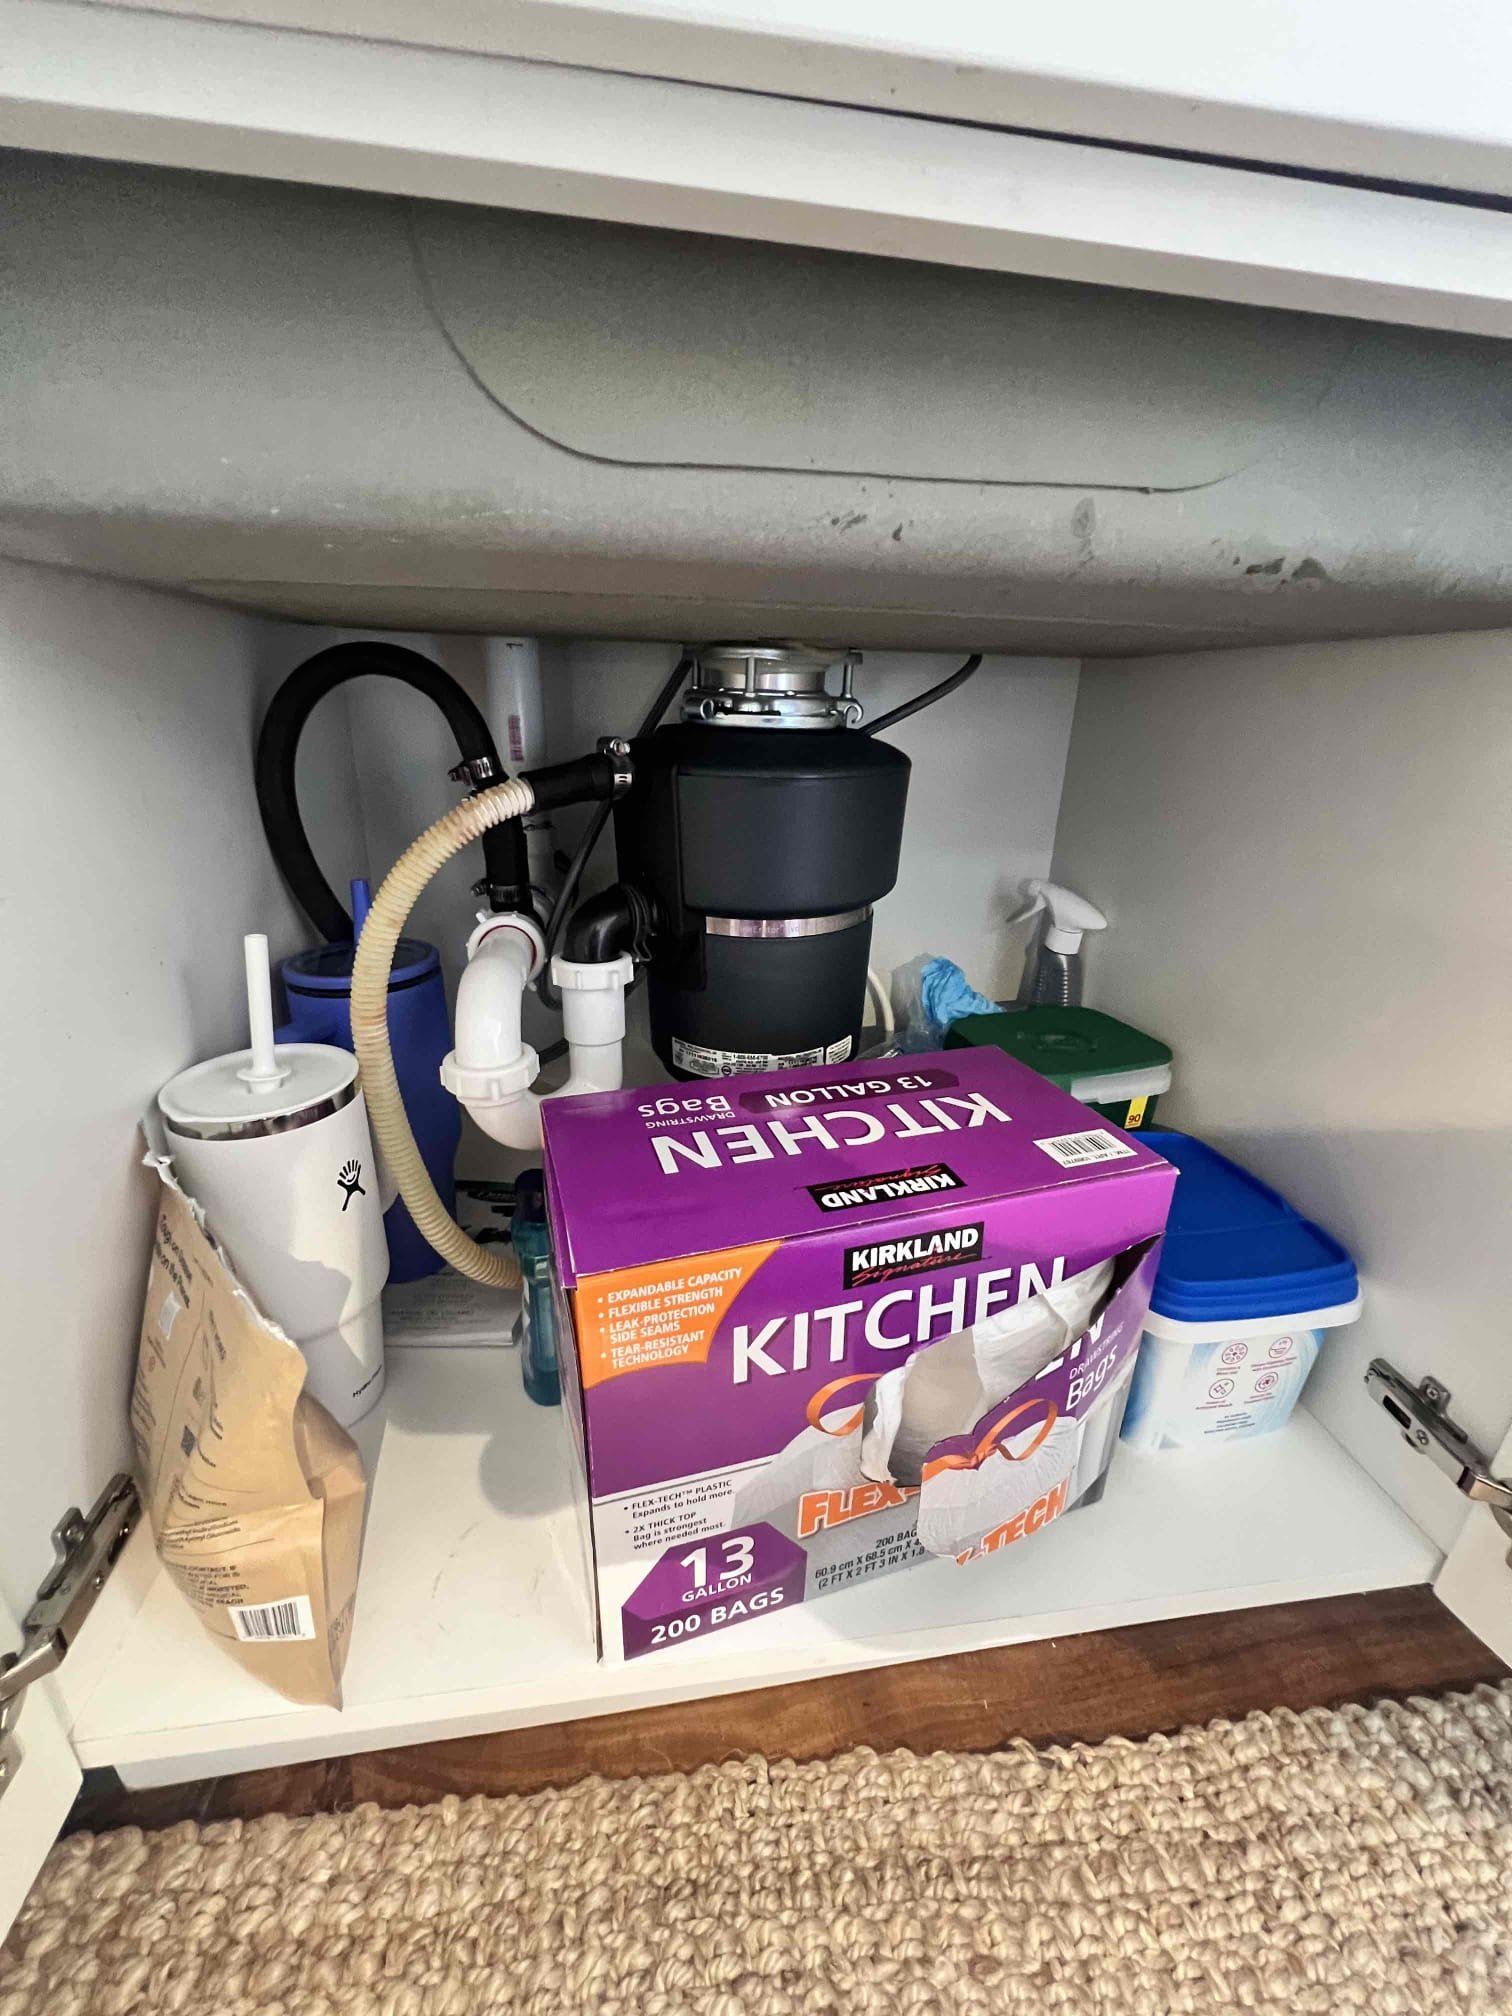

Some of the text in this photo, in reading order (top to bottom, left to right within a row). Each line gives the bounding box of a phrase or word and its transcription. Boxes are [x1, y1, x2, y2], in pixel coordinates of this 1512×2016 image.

[637, 1094, 731, 1117] Bags
[769, 1074, 933, 1108] 13 GALLON
[645, 1111, 736, 1129] DRAWSTRING
[650, 1093, 1013, 1175] KITCHEN
[821, 1173, 956, 1209] KIRKLAND
[852, 1228, 978, 1271] KIRKLAND
[852, 1252, 977, 1287] Signature
[608, 1267, 742, 1303] EXPANDABLE CAPACITY
[608, 1286, 723, 1319] FLEXIBLE STRENGTH
[609, 1303, 715, 1333] LEAK-PROTECTION
[610, 1320, 681, 1345] SIDE SEAMS
[611, 1330, 705, 1359] TEAR-RESISTANT
[612, 1344, 689, 1369] TECHNOLOGY
[1066, 1345, 1118, 1411] Bags
[695, 1480, 732, 1494] PLASTIC
[633, 1489, 734, 1518] Expands to hold more.
[633, 1511, 697, 1534] 2X THICK TOP
[633, 1518, 707, 1543] Bag is strongest
[634, 1538, 662, 1550] where
[665, 1527, 699, 1542] needed
[875, 1528, 917, 1549] 200 BAG
[680, 1535, 755, 1588] 13
[815, 1564, 836, 1578] 60.9
[838, 1560, 854, 1571] cm
[856, 1555, 863, 1565] X
[865, 1548, 886, 1562] 68.5
[888, 1544, 903, 1555] cm
[905, 1539, 912, 1549] X
[818, 1577, 828, 1590] (2
[831, 1573, 844, 1585] FT
[846, 1569, 853, 1579] X
[856, 1566, 862, 1576] 2
[864, 1561, 877, 1573] FT
[879, 1558, 886, 1568] 3
[888, 1554, 899, 1566] IN
[900, 1551, 908, 1561] X
[681, 1573, 752, 1603] GALLON
[651, 1587, 784, 1645] 200 BAGS
